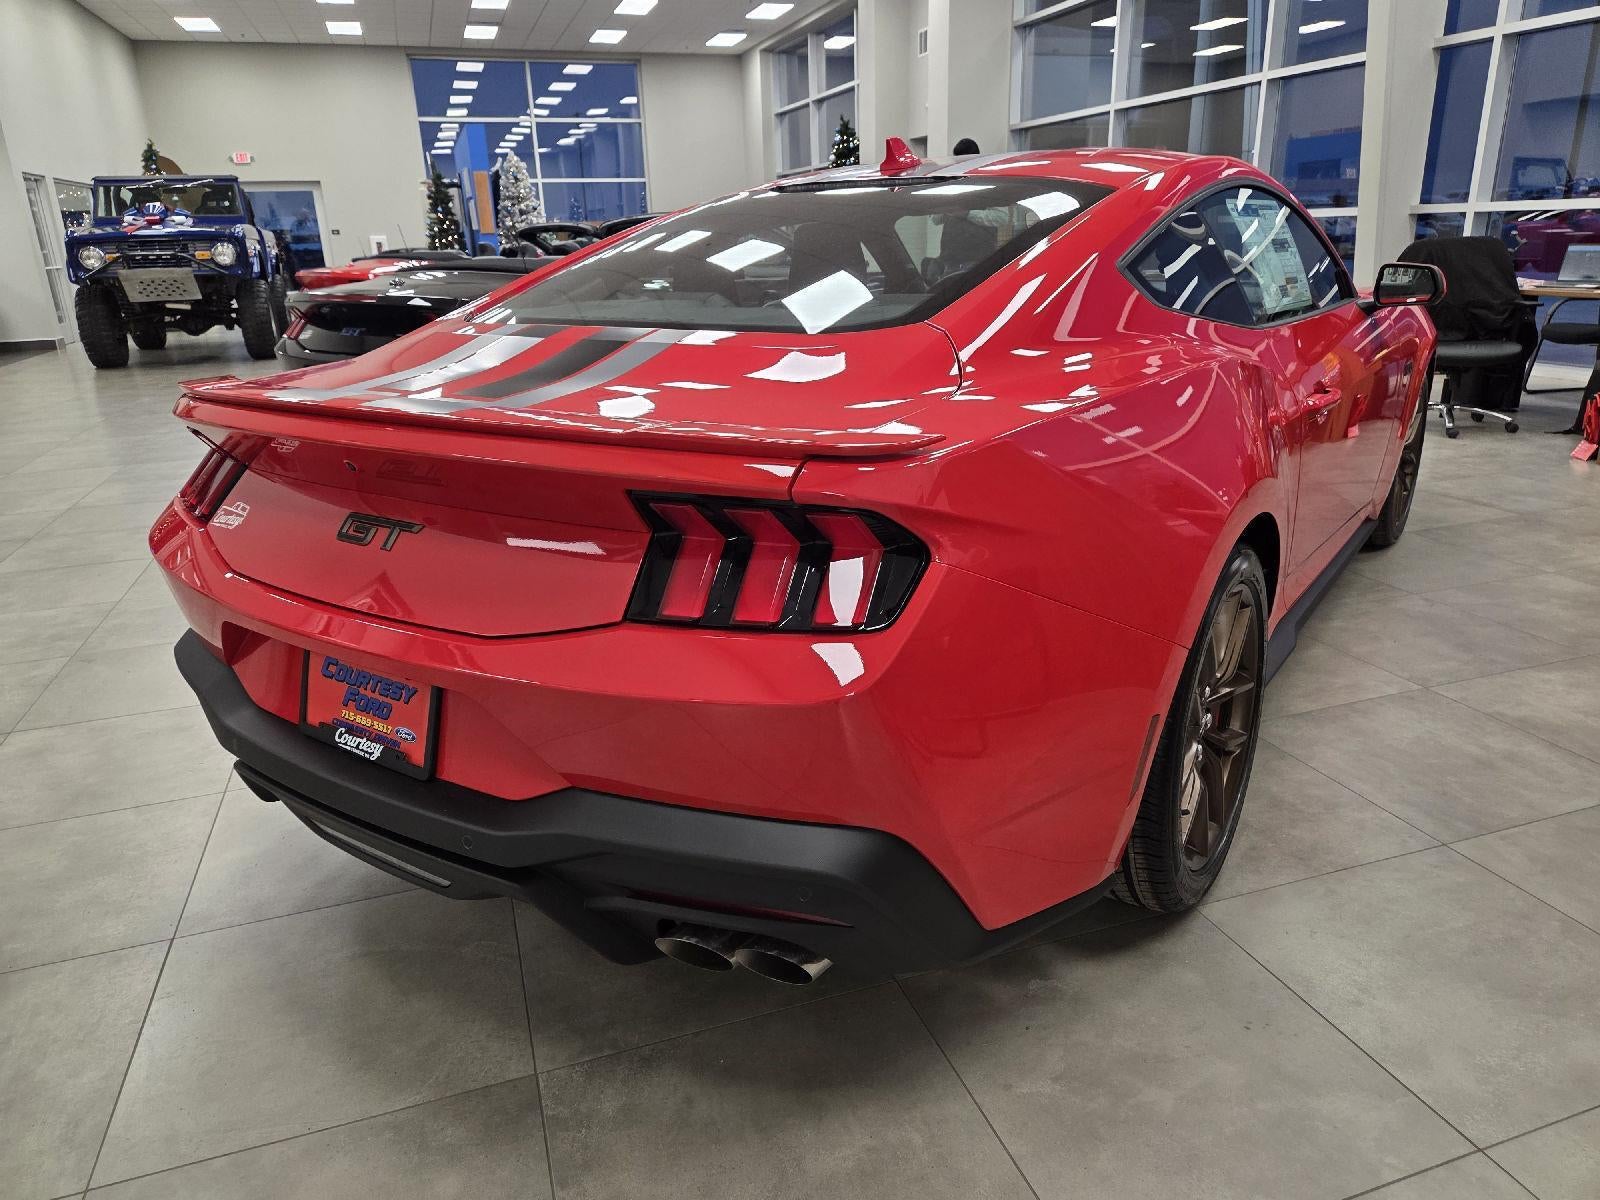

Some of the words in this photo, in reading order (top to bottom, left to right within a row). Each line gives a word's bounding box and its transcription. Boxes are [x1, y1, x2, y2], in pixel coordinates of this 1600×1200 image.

[235, 152, 248, 162] EXIT
[336, 511, 425, 552] GT
[334, 727, 385, 761] Courtesy
[395, 727, 413, 741] Ford
